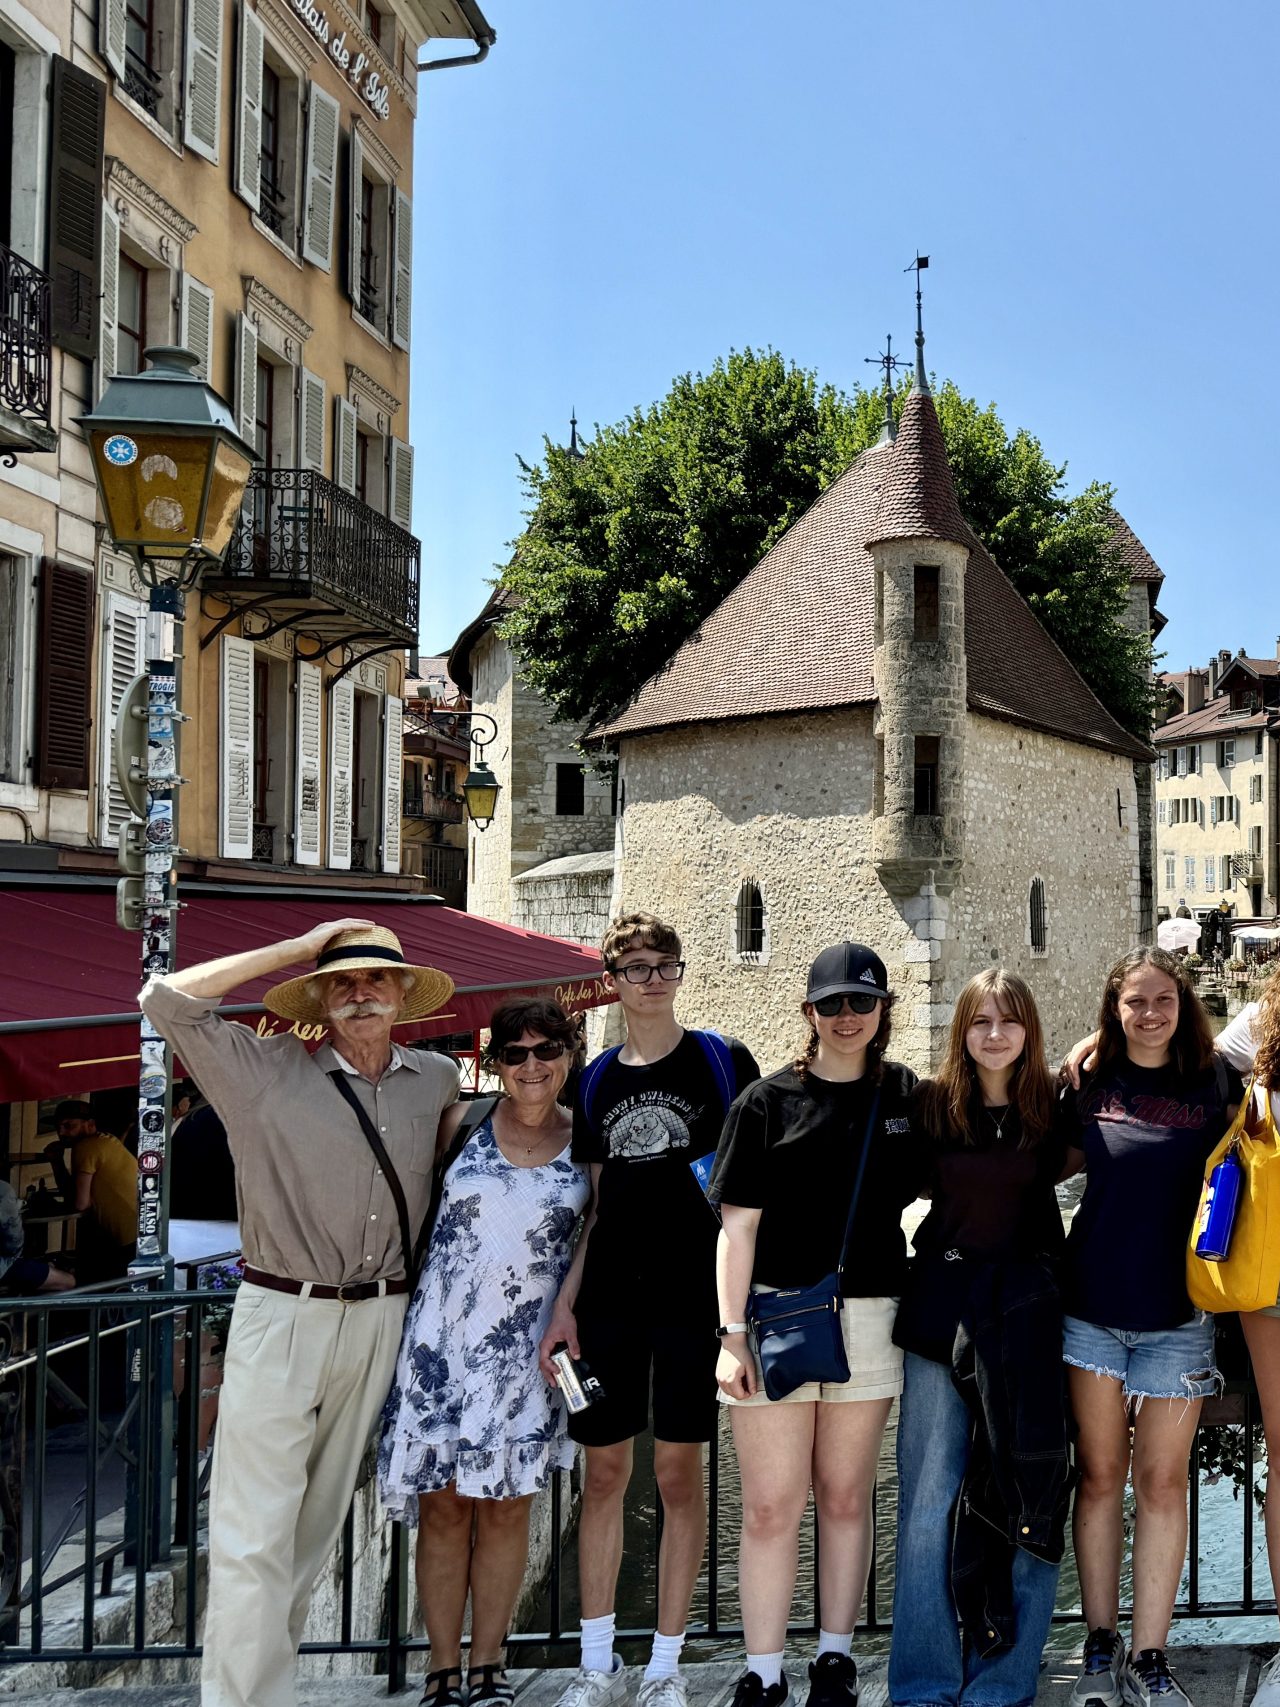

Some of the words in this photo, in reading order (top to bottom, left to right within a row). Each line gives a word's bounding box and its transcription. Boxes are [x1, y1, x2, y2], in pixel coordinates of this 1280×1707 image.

[332, 31, 350, 69] de
[366, 72, 390, 121] Isle
[1130, 1094, 1207, 1129] Miss
[145, 1202, 157, 1234] LASO
